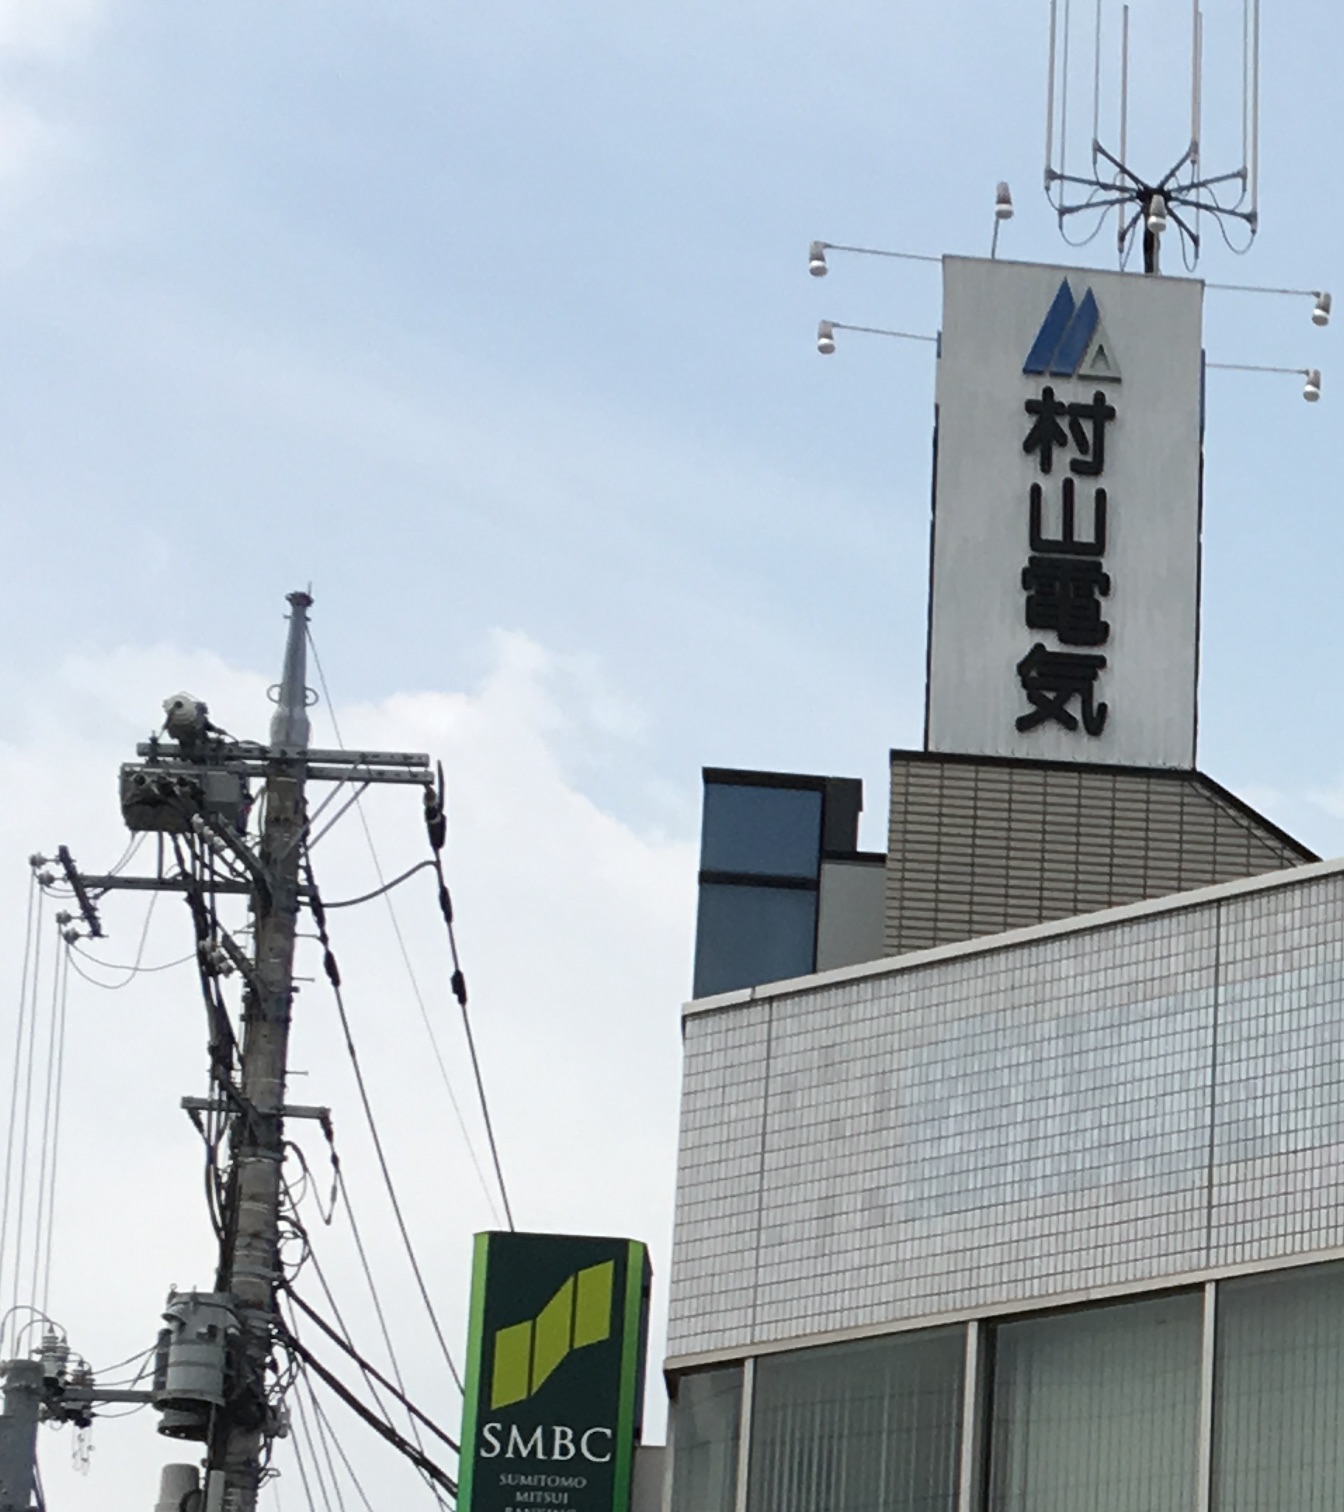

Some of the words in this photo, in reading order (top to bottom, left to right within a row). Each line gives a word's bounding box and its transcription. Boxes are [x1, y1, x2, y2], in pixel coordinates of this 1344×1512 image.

[1015, 386, 1116, 736] 村山電気
[479, 1422, 612, 1463] SMBC
[499, 1473, 588, 1489] SUMITOMO
[515, 1491, 569, 1504] MITSUI
